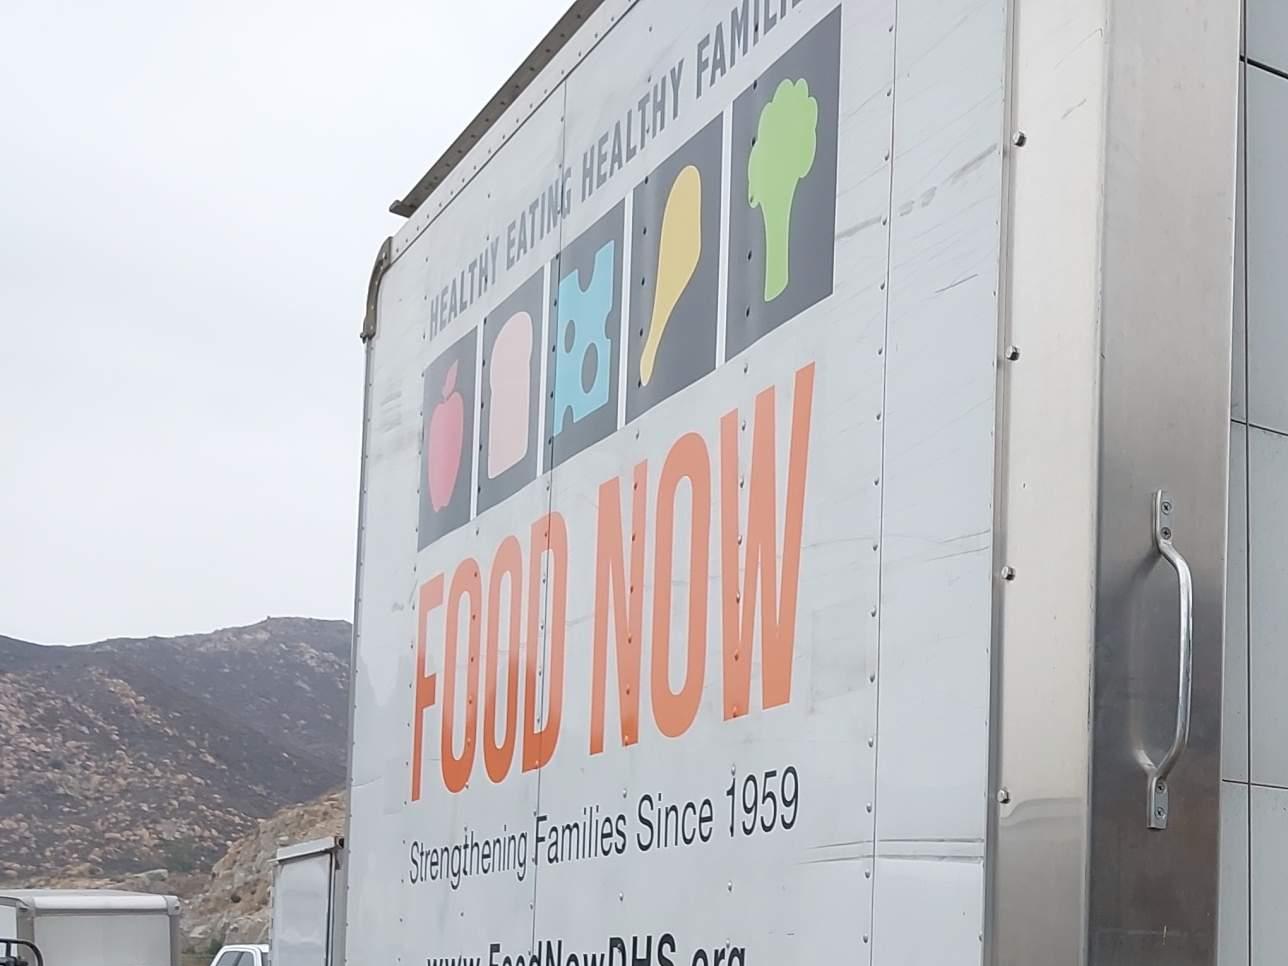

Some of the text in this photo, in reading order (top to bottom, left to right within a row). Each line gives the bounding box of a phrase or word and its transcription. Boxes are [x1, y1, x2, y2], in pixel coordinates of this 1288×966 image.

[429, 236, 499, 341] HEALTHY
[506, 165, 572, 272] EATING
[580, 58, 684, 203] HEALTHY
[412, 361, 815, 801] FOOD NOW
[409, 766, 799, 890] Strengthening Families Since 1959
